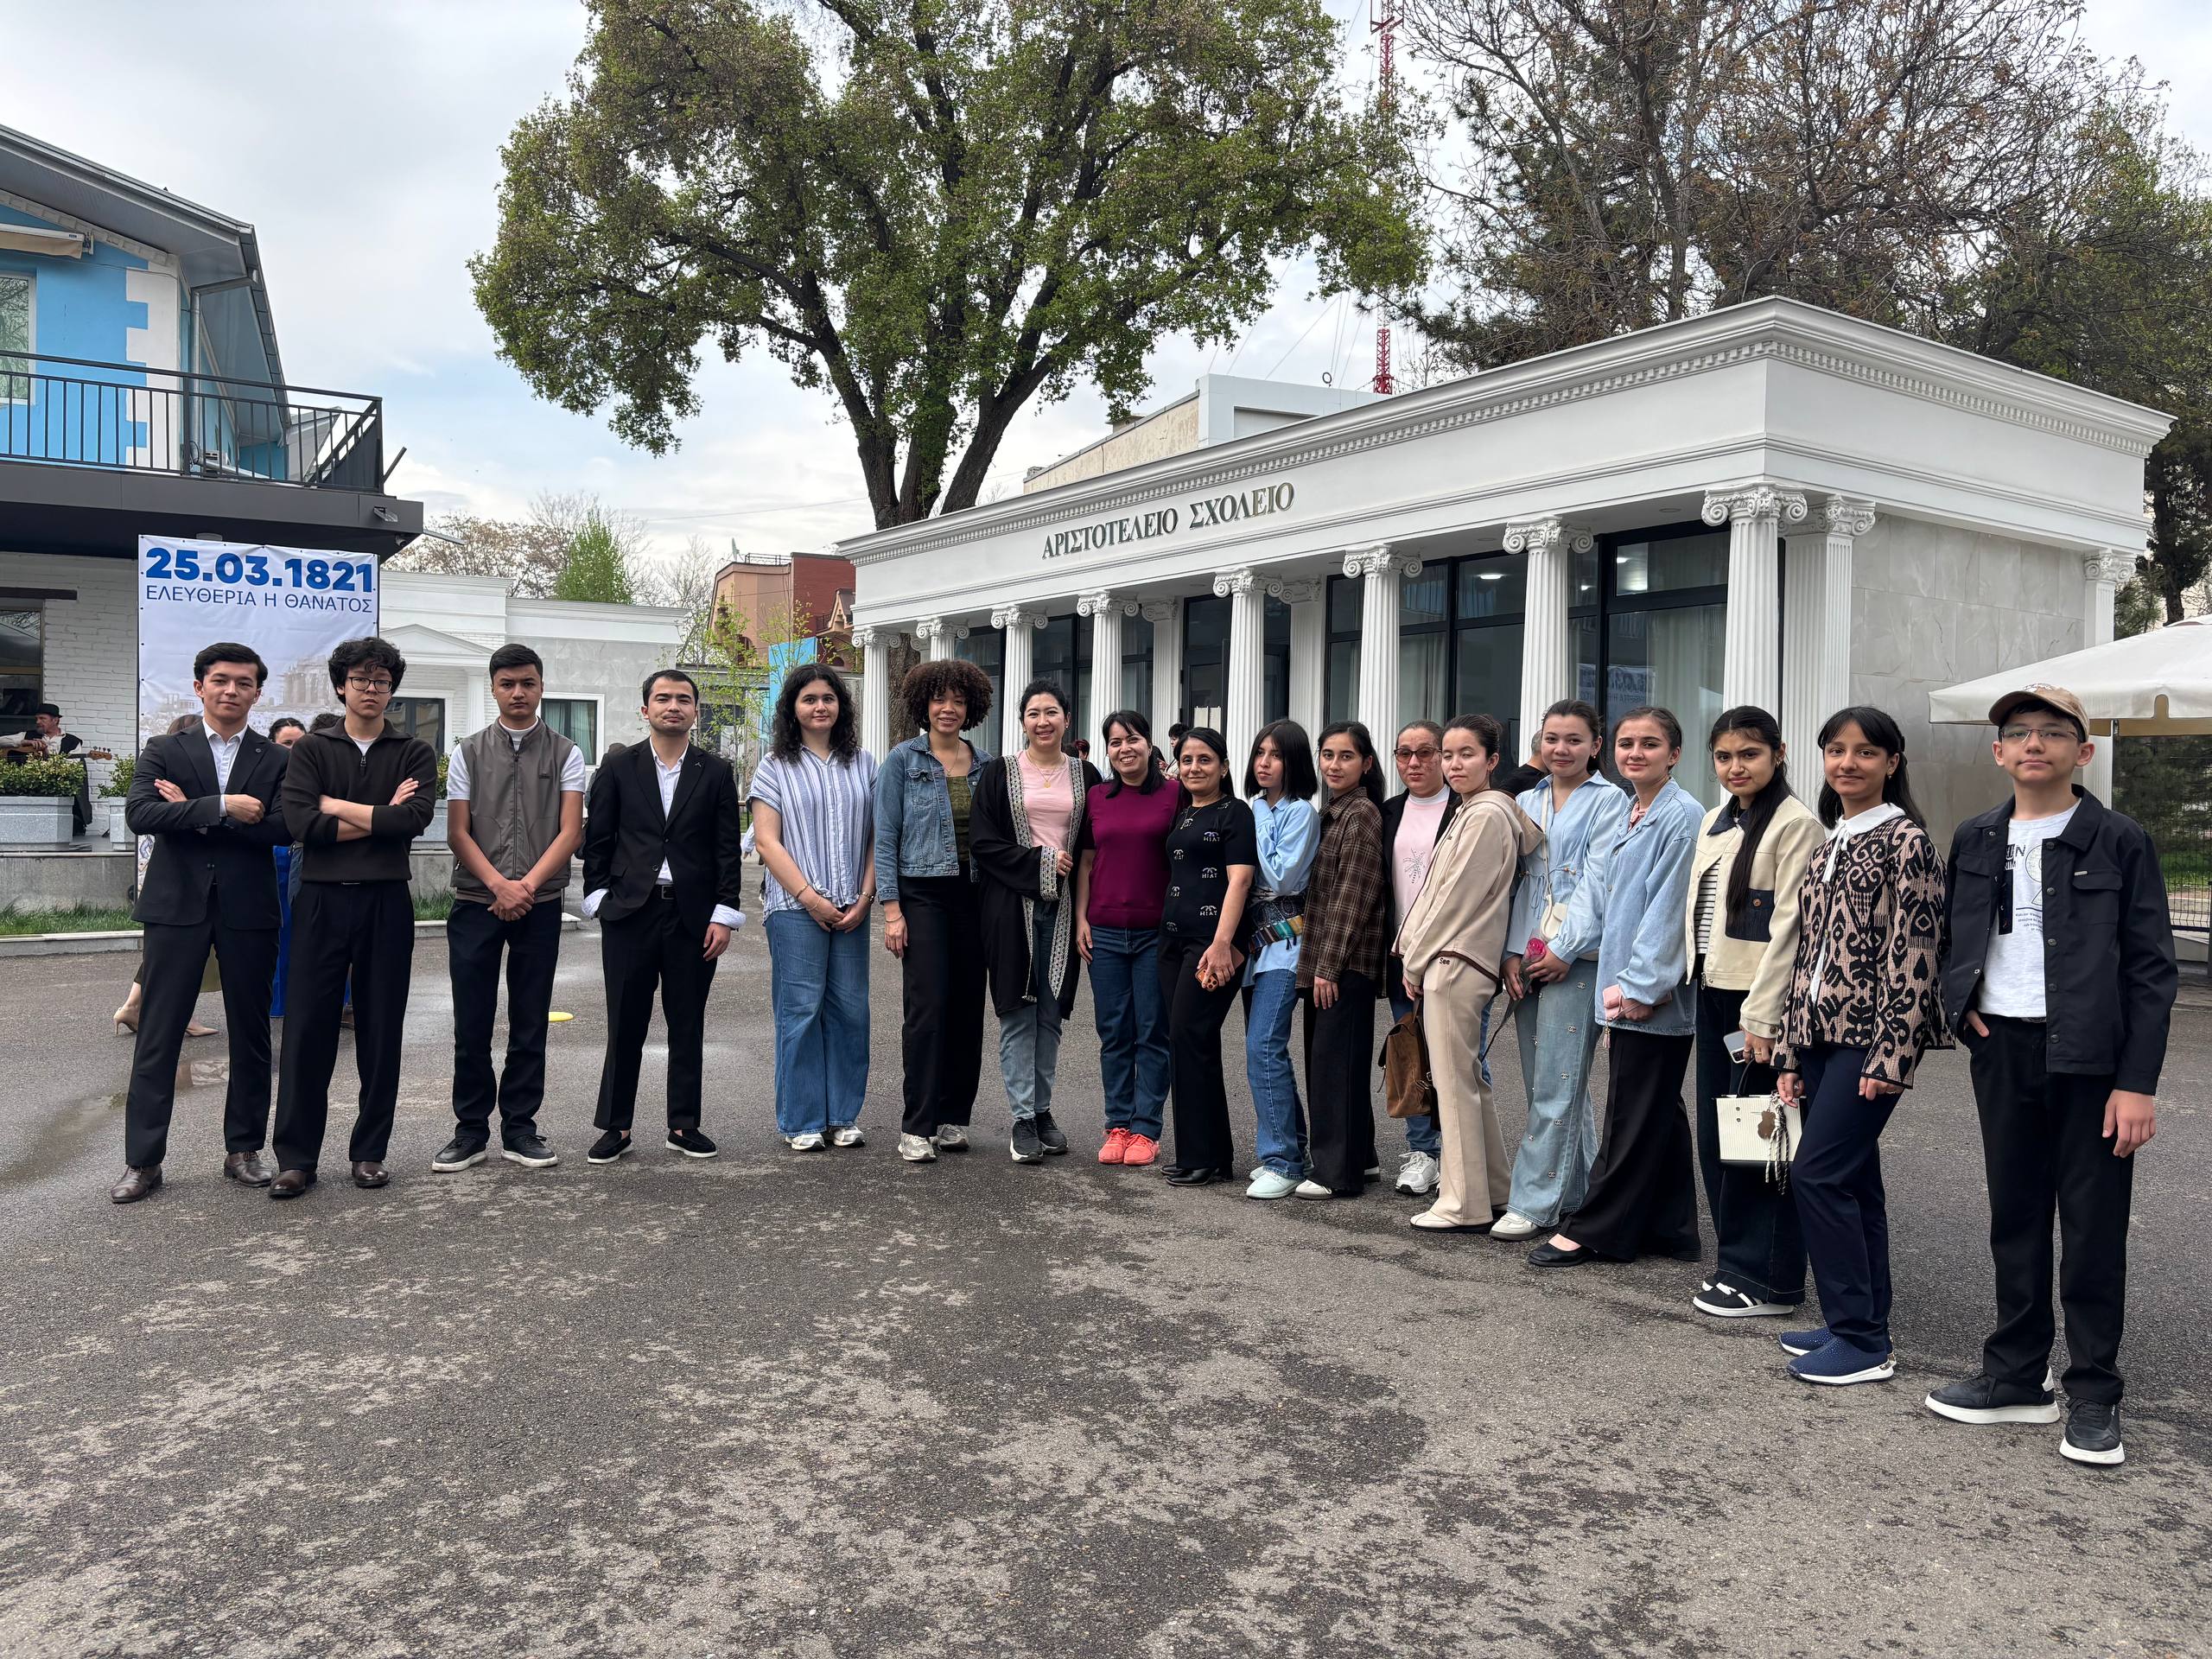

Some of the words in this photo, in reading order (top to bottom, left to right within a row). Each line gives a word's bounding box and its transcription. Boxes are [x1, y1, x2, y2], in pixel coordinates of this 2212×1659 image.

[1042, 508, 1178, 559] ΑΡΙΣΤΟΤΕΛΕΙΟ
[1189, 482, 1294, 530] ΣΧΟΛΕΙΟ
[146, 548, 372, 593] 25.03.1821
[146, 585, 257, 607] ΕΛΕΥΘΕΡΙΑ
[264, 593, 276, 607] Η
[284, 594, 372, 613] ΘΑΝΑΤΟΣ
